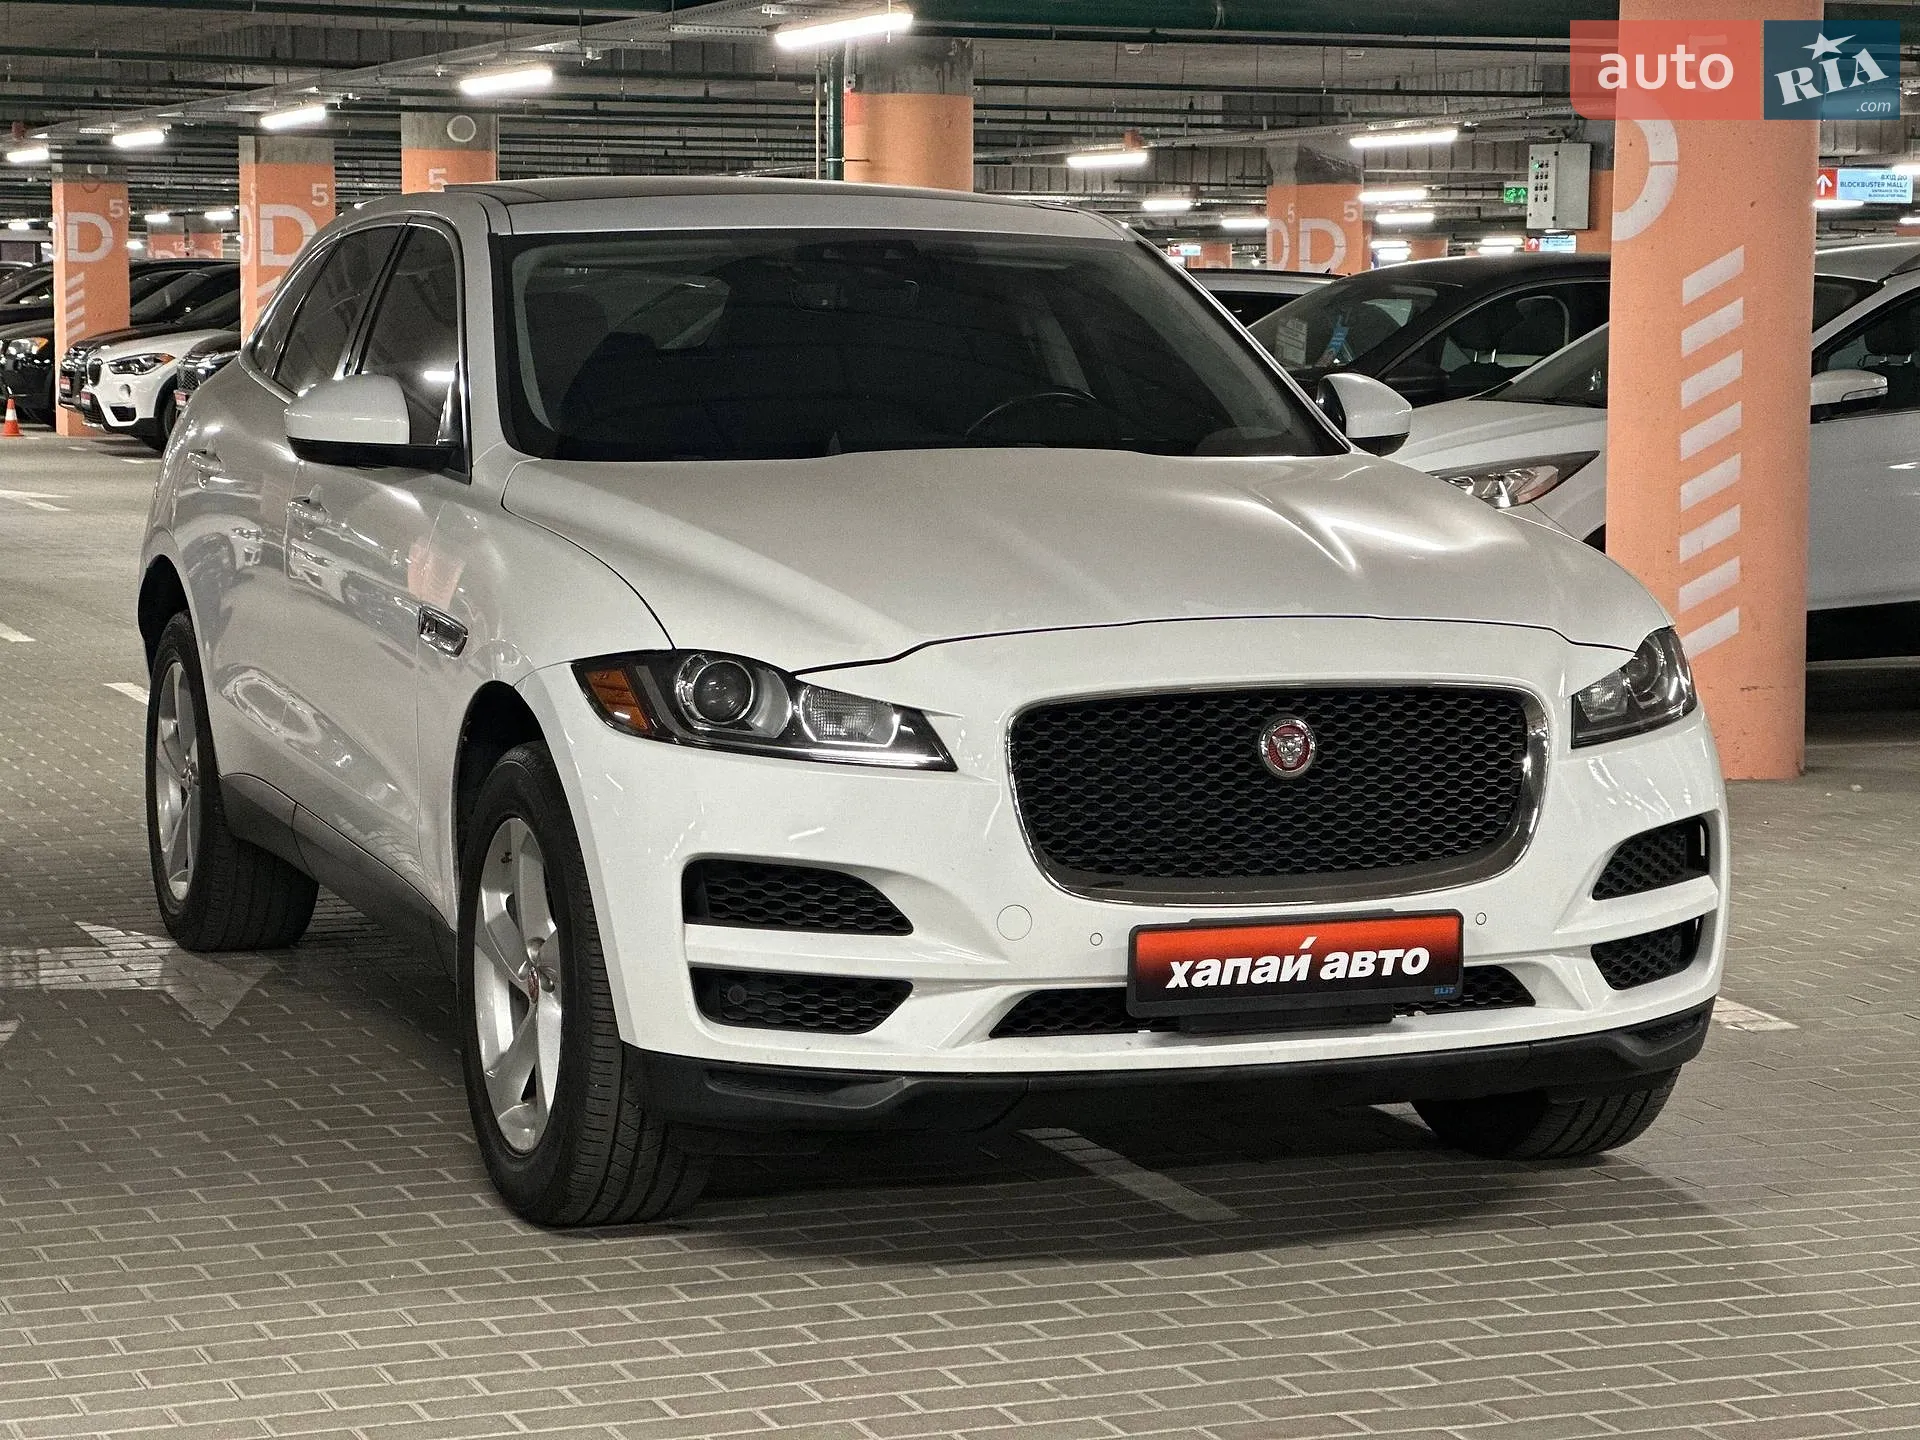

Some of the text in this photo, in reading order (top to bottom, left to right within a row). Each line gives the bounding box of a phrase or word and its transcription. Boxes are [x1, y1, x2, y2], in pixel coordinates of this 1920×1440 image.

[428, 167, 447, 192] 5
[109, 199, 125, 219] 5
[311, 183, 330, 207] 5
[1343, 201, 1359, 222] 5
[66, 211, 114, 263] D
[259, 203, 318, 266] D
[1299, 217, 1347, 272] D
[1319, 947, 1430, 980] авто
